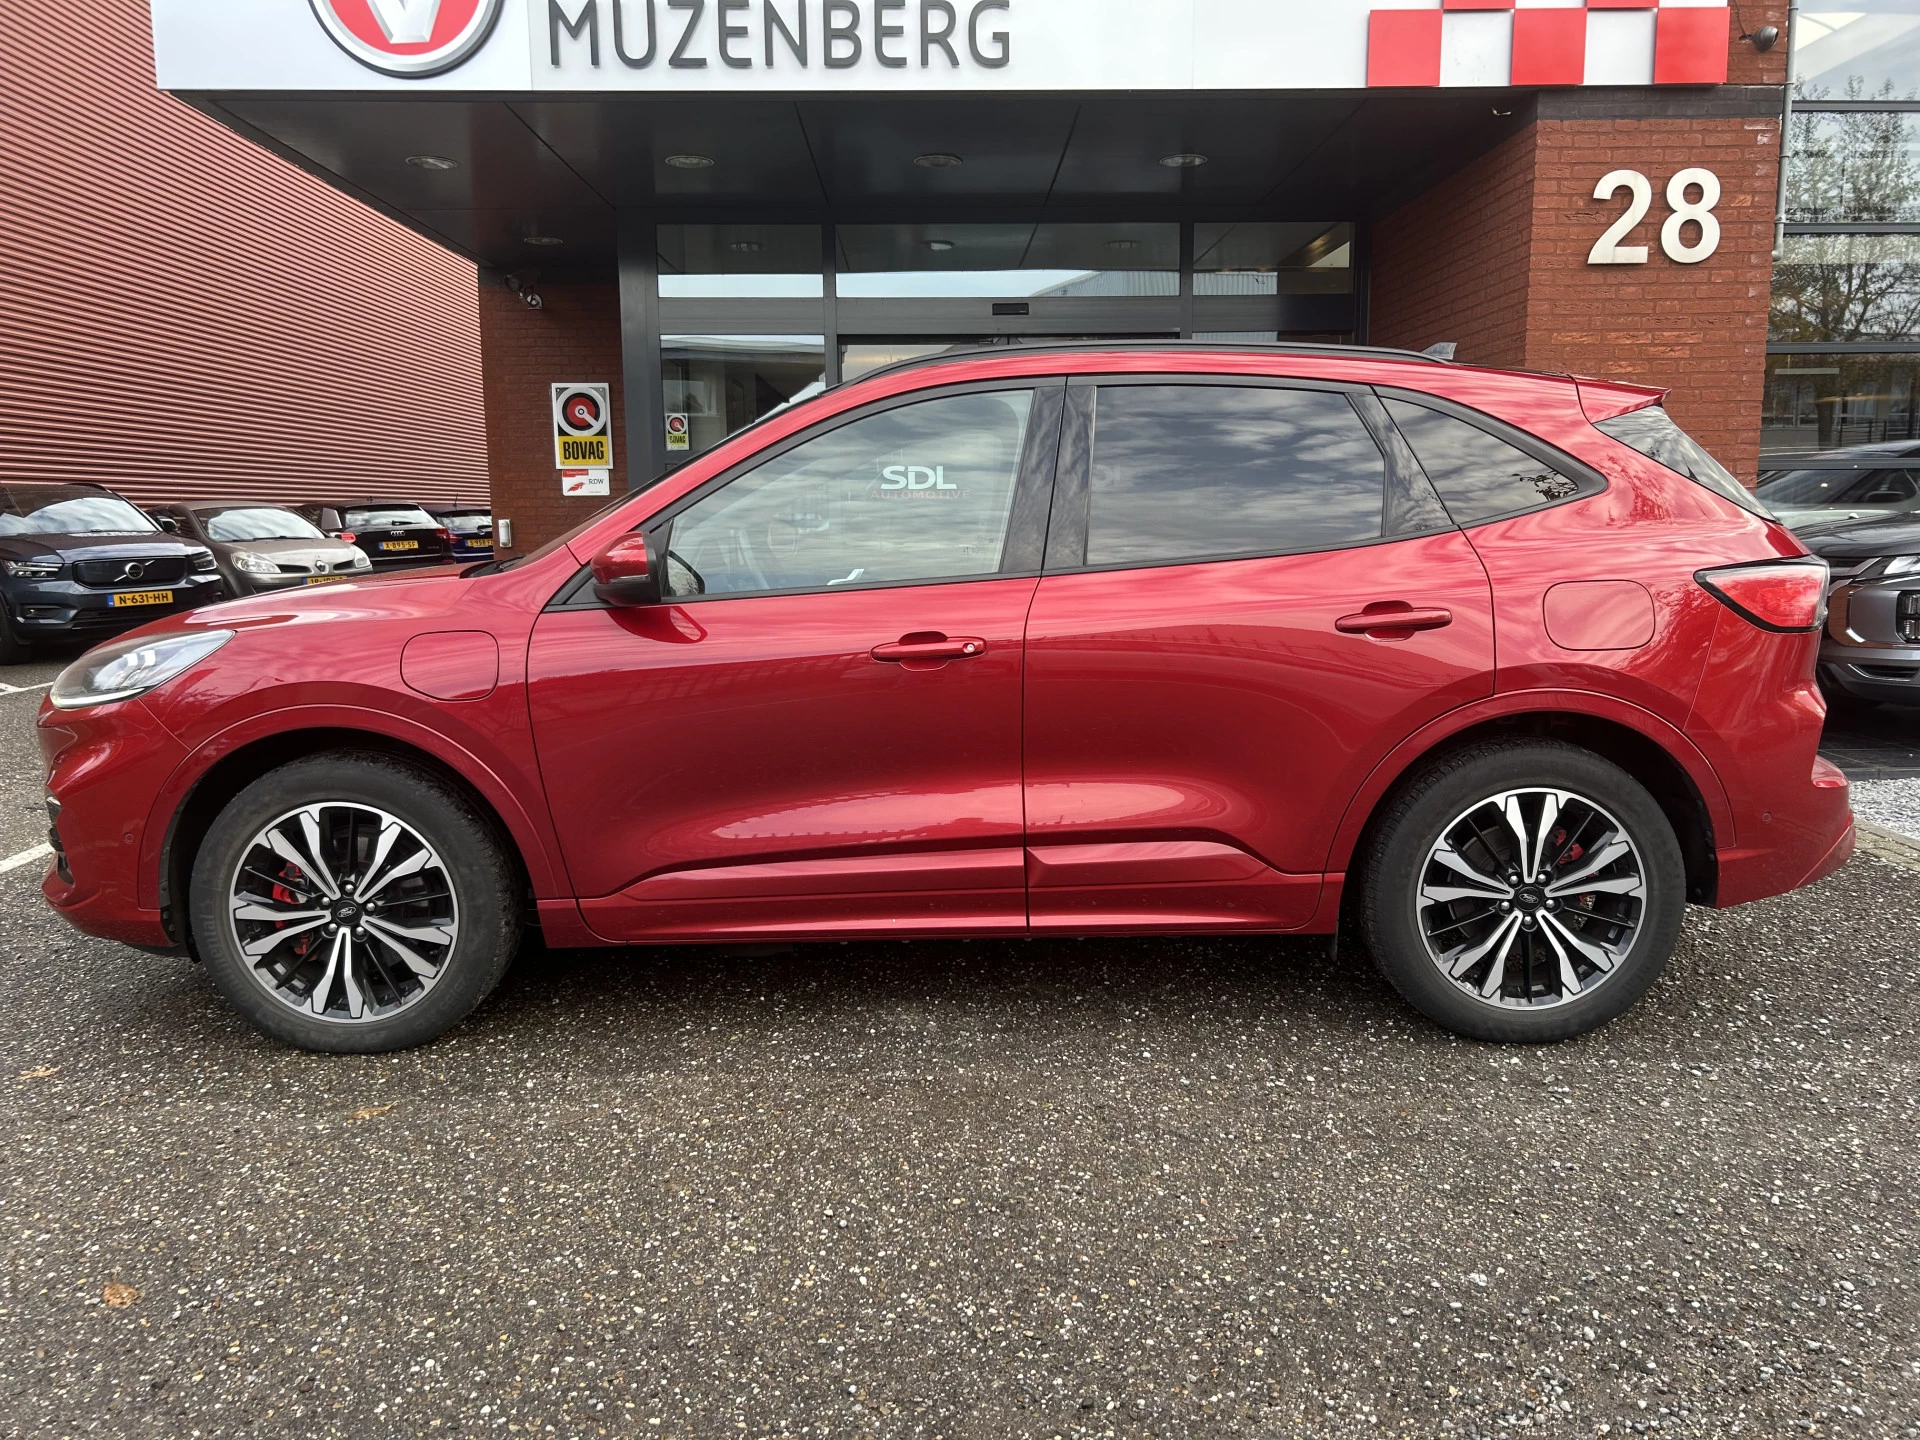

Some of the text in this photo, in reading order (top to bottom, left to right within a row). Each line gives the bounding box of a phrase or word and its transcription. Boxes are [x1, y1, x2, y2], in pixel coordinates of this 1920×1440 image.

[548, 0, 1010, 69] MUZENBERG
[1587, 167, 1721, 265] 28
[562, 440, 605, 460] BOVAG
[880, 465, 957, 490] SDL
[870, 490, 971, 500] AUTOMOTIVE
[118, 591, 169, 605] N-631-HH
